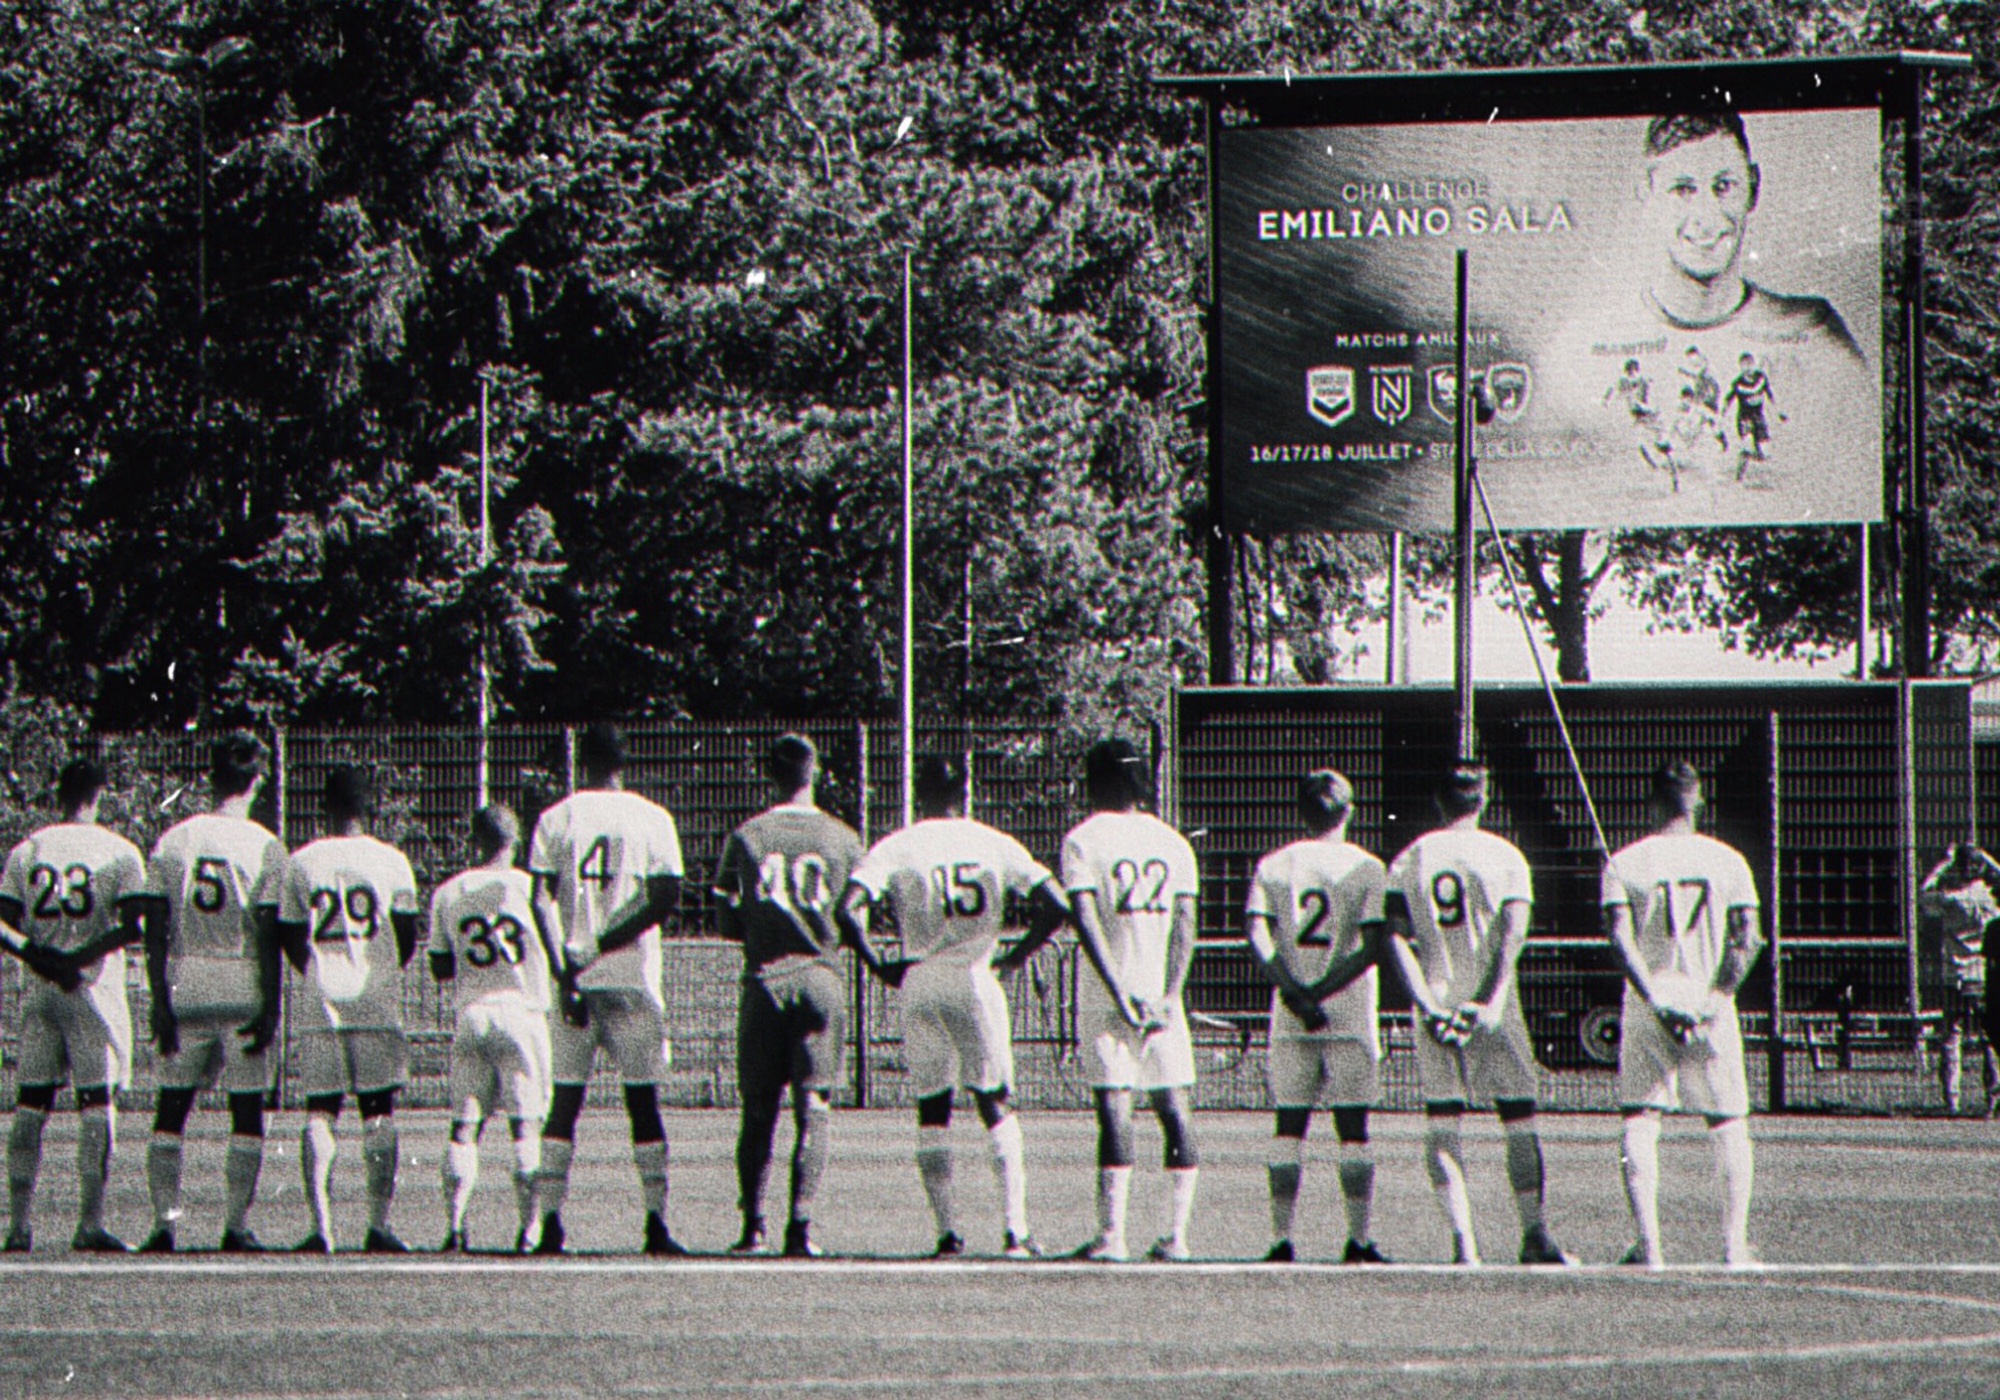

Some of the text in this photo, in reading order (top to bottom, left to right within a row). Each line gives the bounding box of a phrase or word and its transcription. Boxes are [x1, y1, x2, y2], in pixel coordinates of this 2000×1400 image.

[1341, 180, 1490, 203] CHALLENGE
[1258, 203, 1572, 240] EMILIANO SALA
[1336, 333, 1409, 348] MATCHS
[1250, 443, 1333, 463] 16/17/18
[1336, 441, 1412, 461] JUILLET
[193, 856, 228, 912] 5
[579, 836, 613, 881] 4
[1112, 858, 1168, 913] 22
[27, 863, 94, 918] 23
[309, 886, 379, 943] 29
[932, 862, 987, 917] 15
[1297, 887, 1331, 946] 2
[1431, 870, 1466, 926] 9
[1655, 877, 1711, 937] 17
[458, 915, 526, 967] 33
